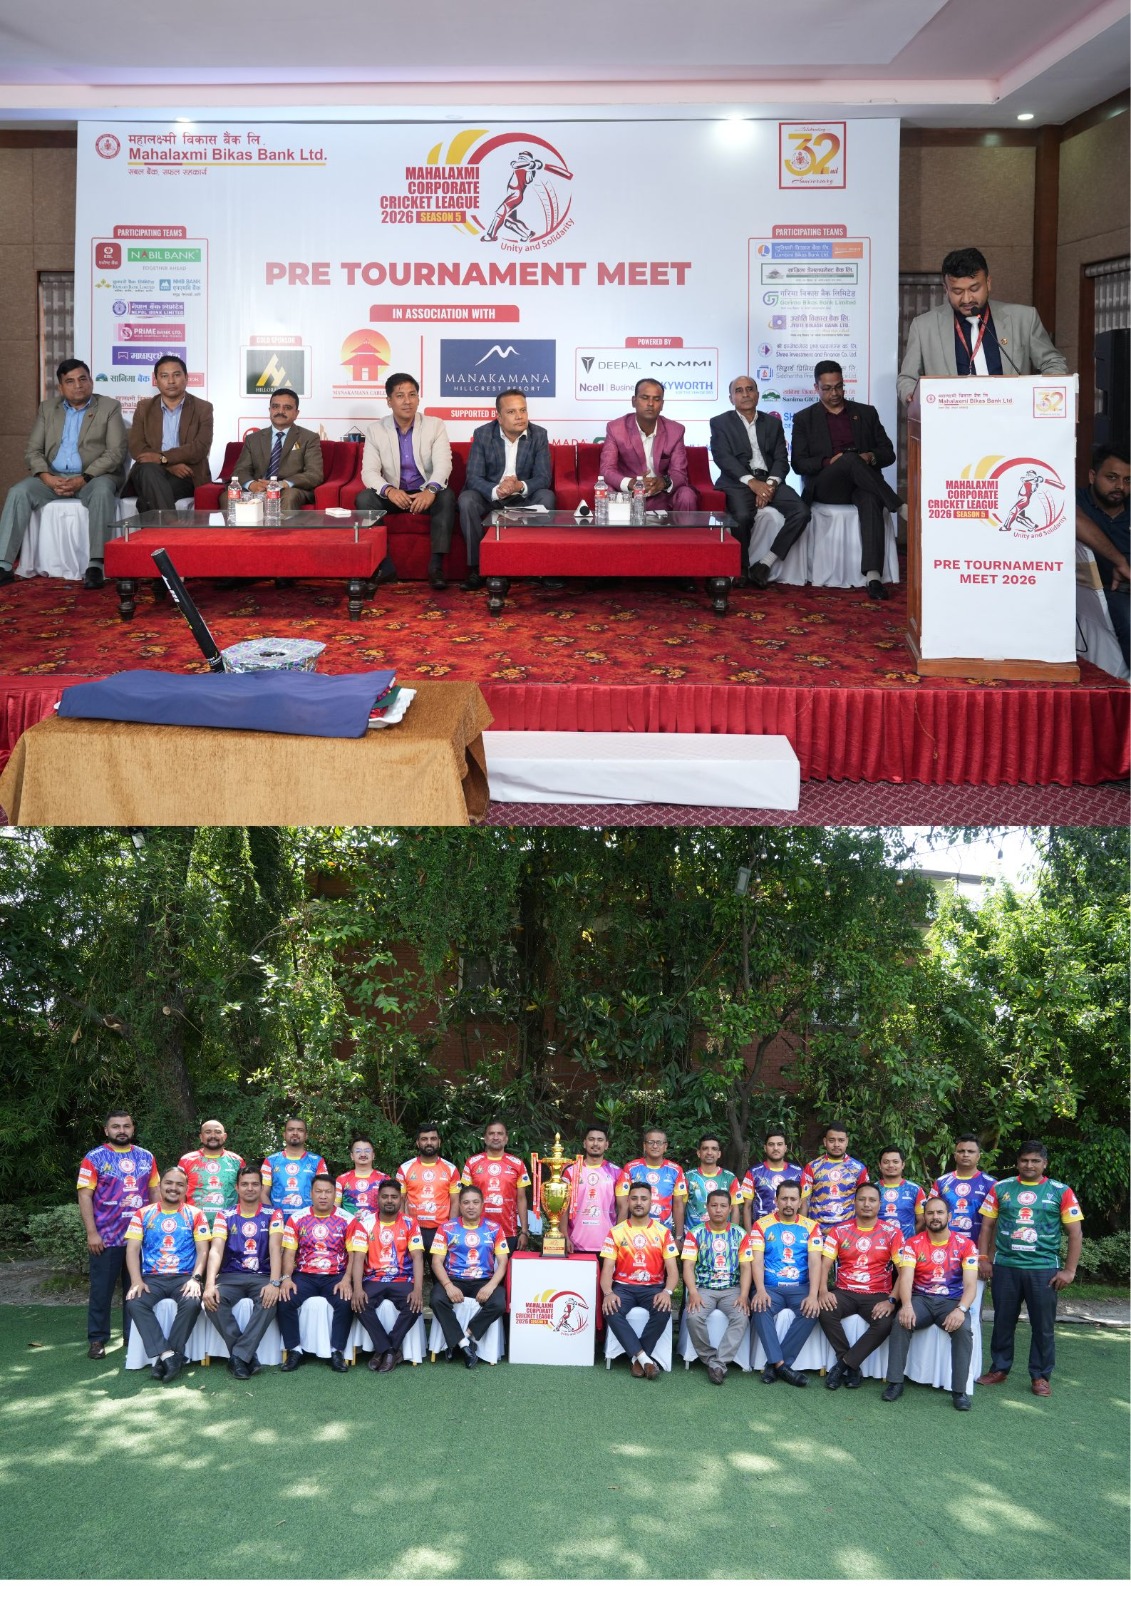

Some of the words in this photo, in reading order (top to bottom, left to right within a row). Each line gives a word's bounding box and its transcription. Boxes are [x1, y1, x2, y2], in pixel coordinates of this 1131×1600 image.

[127, 132, 177, 147] महालक्ष्मी
[183, 132, 217, 145] विकास
[223, 131, 241, 145] बैंक
[128, 148, 207, 161] Mahalaxmi
[212, 148, 252, 161] Bikas
[258, 148, 295, 161] Bank
[300, 148, 328, 161] Ltd.
[784, 133, 840, 176] 32
[406, 167, 480, 180] MAHALAXMI
[408, 181, 480, 194] CORPORATE
[380, 196, 432, 209] CRICKET
[435, 196, 480, 209] LEAGUE
[381, 211, 414, 224] 2026
[420, 212, 454, 222] SEASON
[456, 212, 462, 222] 5
[117, 229, 161, 237] PARTICIPATING
[163, 229, 183, 237] TEAMS
[500, 242, 523, 254] Unity
[524, 241, 541, 252] and
[542, 217, 575, 248] Solidarity
[775, 228, 821, 236] PARTICIPATING
[823, 228, 844, 236] TEAMS
[131, 250, 164, 259] NABIL
[165, 251, 196, 260] BANK
[265, 262, 331, 286] PRE
[341, 261, 587, 286] TOURNAMENT
[597, 261, 692, 286] MEET
[392, 309, 402, 319] IN
[405, 309, 468, 319] ASSOCIATION
[471, 308, 496, 319] WITH
[598, 361, 642, 369] DEEPAL
[445, 373, 550, 383] MANAKAMANA
[580, 383, 604, 392] Ncell
[610, 383, 635, 392] Busine
[662, 381, 713, 390] KYWORTH
[450, 409, 489, 418] SUPPORTED
[945, 480, 999, 489] MAHALAXMI
[947, 490, 999, 499] CORPORATE
[928, 500, 965, 509] CRICKET
[967, 500, 999, 509] LEAGUE
[928, 510, 952, 519] 2026
[1013, 532, 1030, 540] Unity
[1031, 531, 1043, 539] and
[1043, 515, 1067, 536] Solidarity
[933, 559, 960, 570] PRE
[964, 560, 1064, 571] TOURNAMENT
[960, 574, 998, 584] MEET
[1002, 574, 1036, 585] 2026
